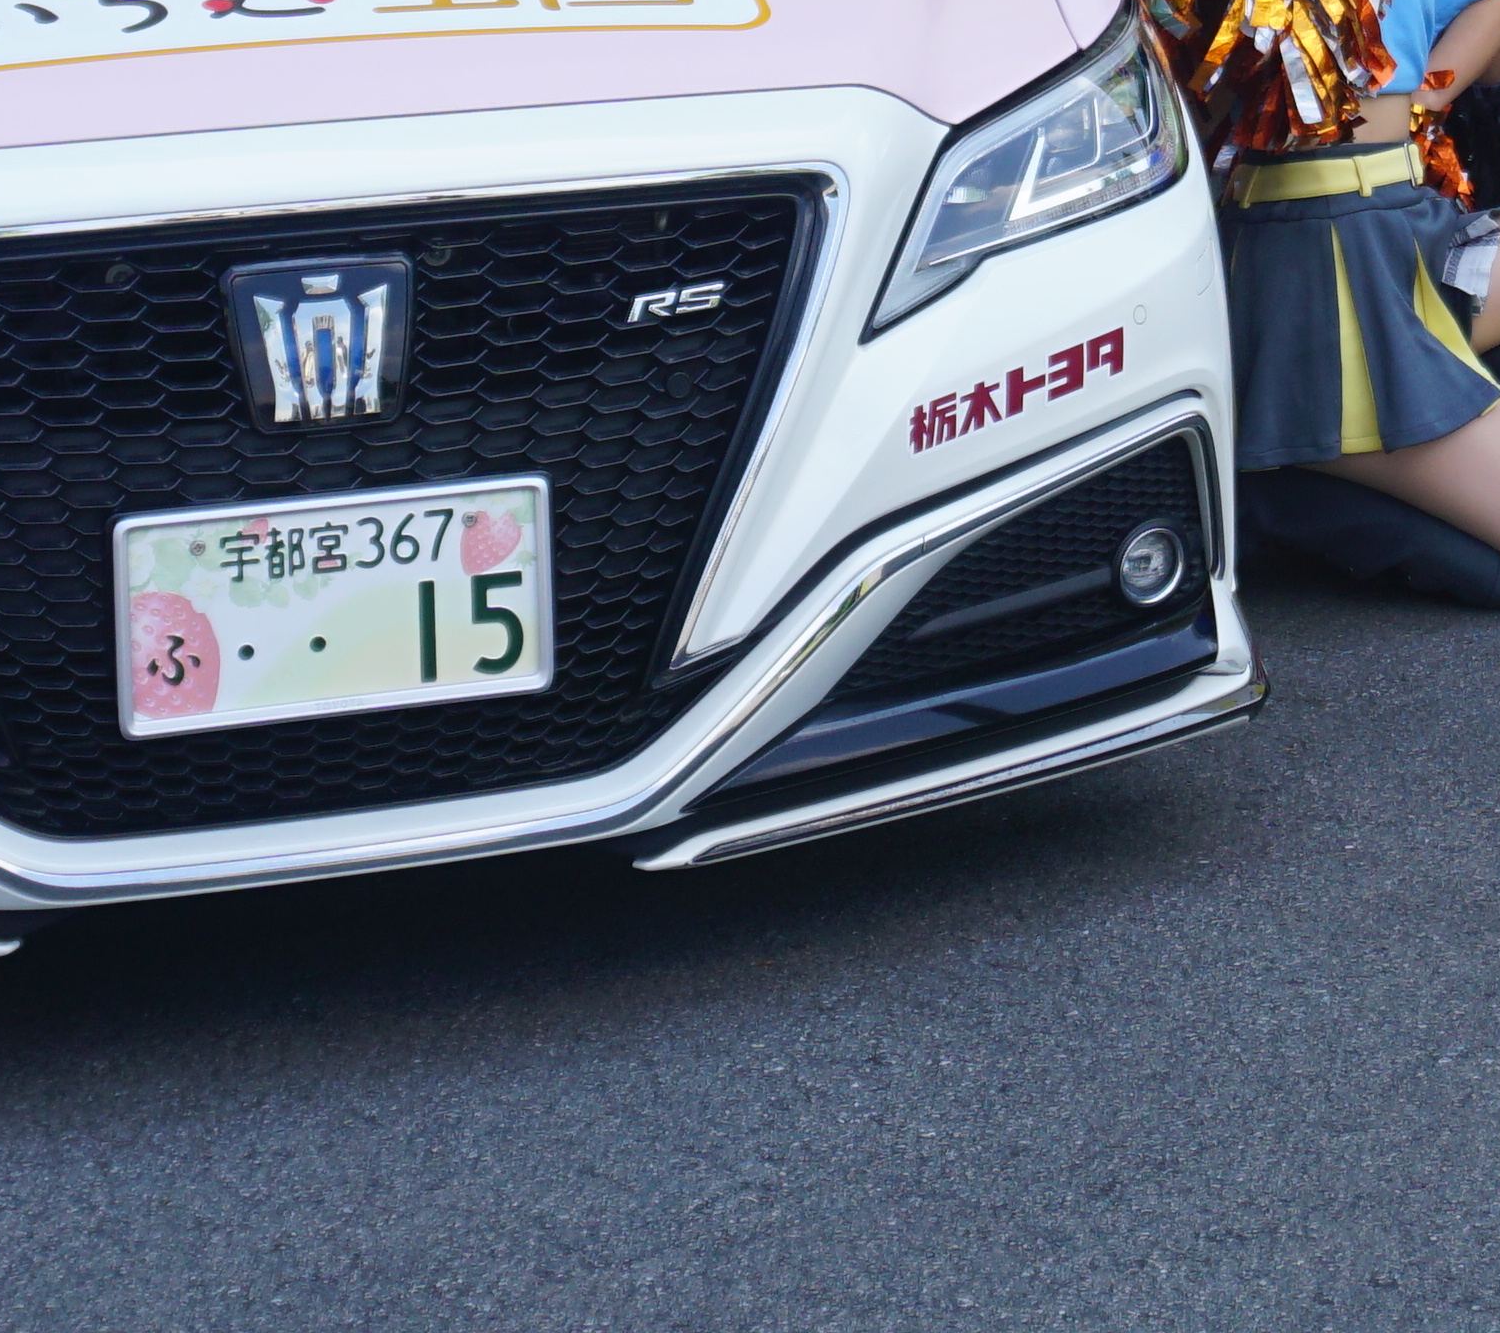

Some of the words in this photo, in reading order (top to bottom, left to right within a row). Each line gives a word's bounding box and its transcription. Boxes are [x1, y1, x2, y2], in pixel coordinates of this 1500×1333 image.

[626, 280, 726, 324] RS
[908, 326, 1126, 455] 栃木トヨタ
[219, 507, 455, 583] 宇都宮367
[146, 634, 201, 687] ふ
